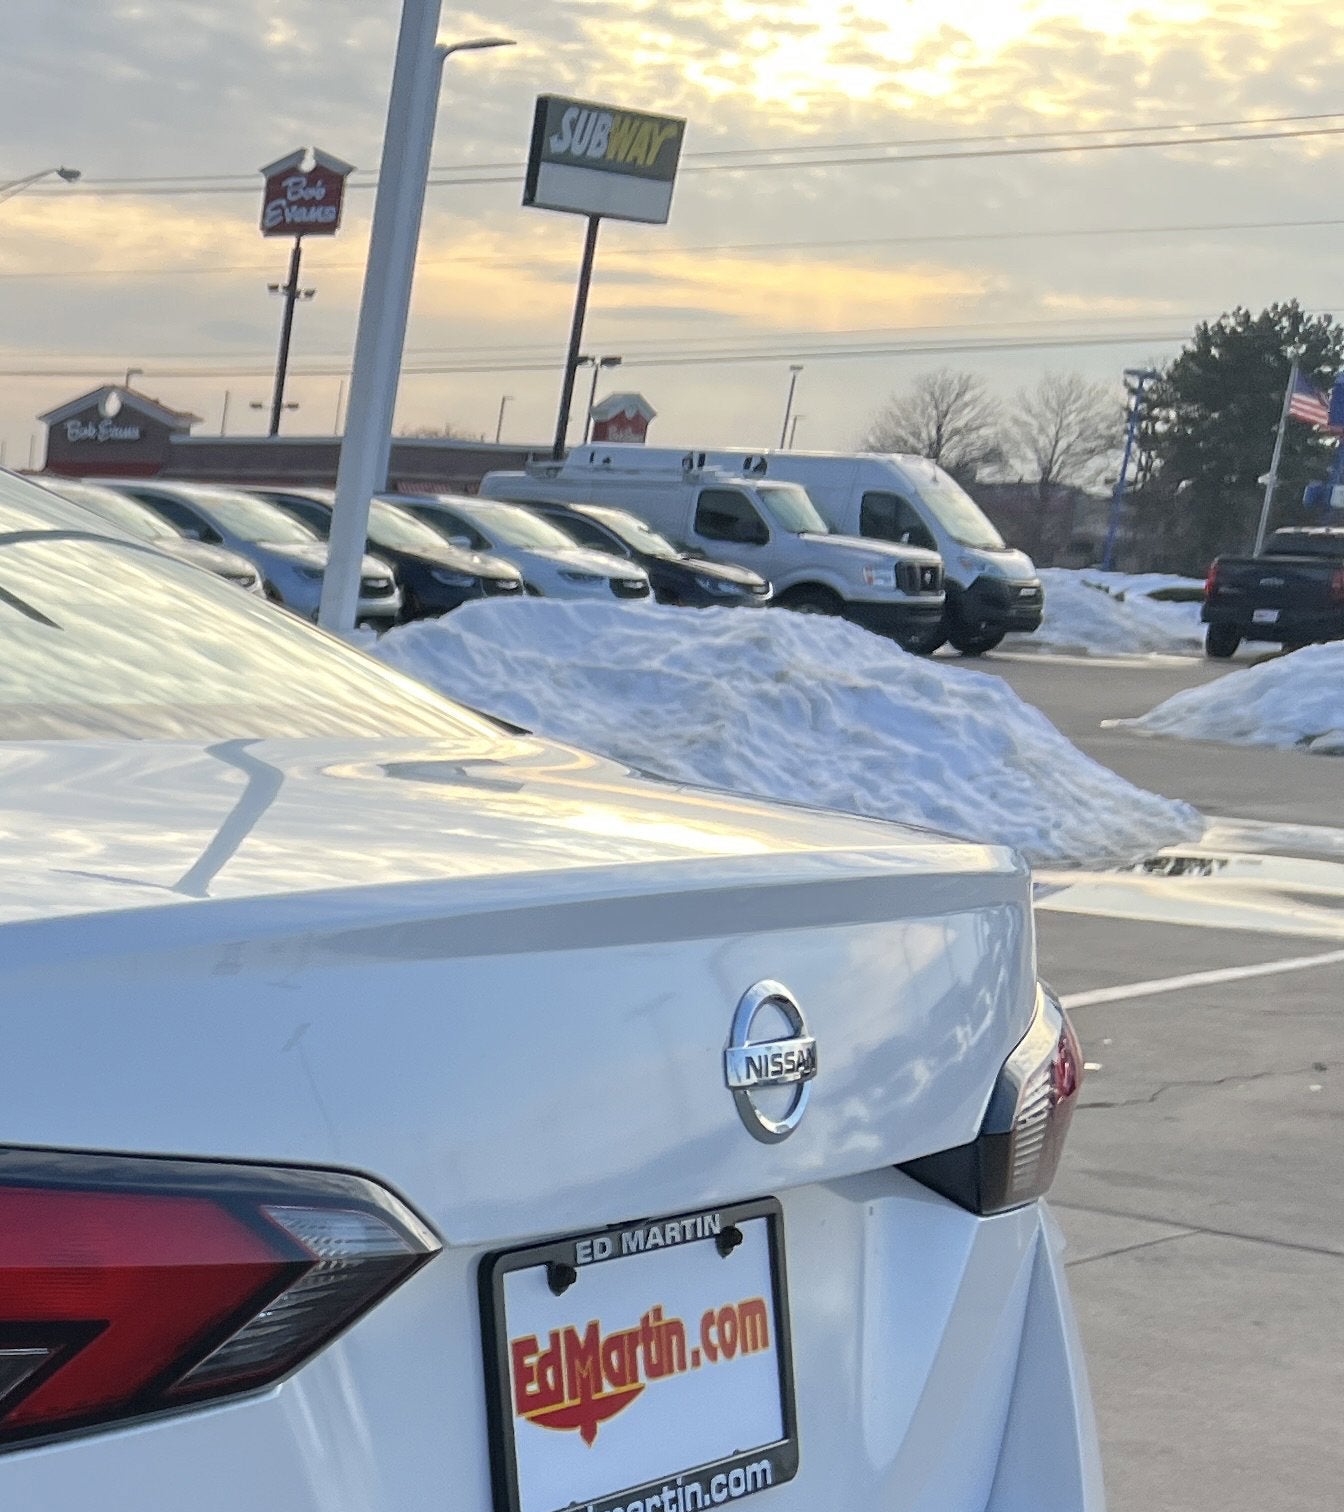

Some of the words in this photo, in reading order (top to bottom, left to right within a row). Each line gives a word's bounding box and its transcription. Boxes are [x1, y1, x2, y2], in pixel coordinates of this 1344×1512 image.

[550, 107, 676, 167] SUBWAY
[281, 175, 326, 201] Bob
[263, 198, 337, 228] Evans
[744, 1047, 816, 1080] NISSAN
[575, 1237, 614, 1266] ED
[621, 1214, 721, 1253] MARTIN
[511, 1297, 769, 1416] EdMartin.com
